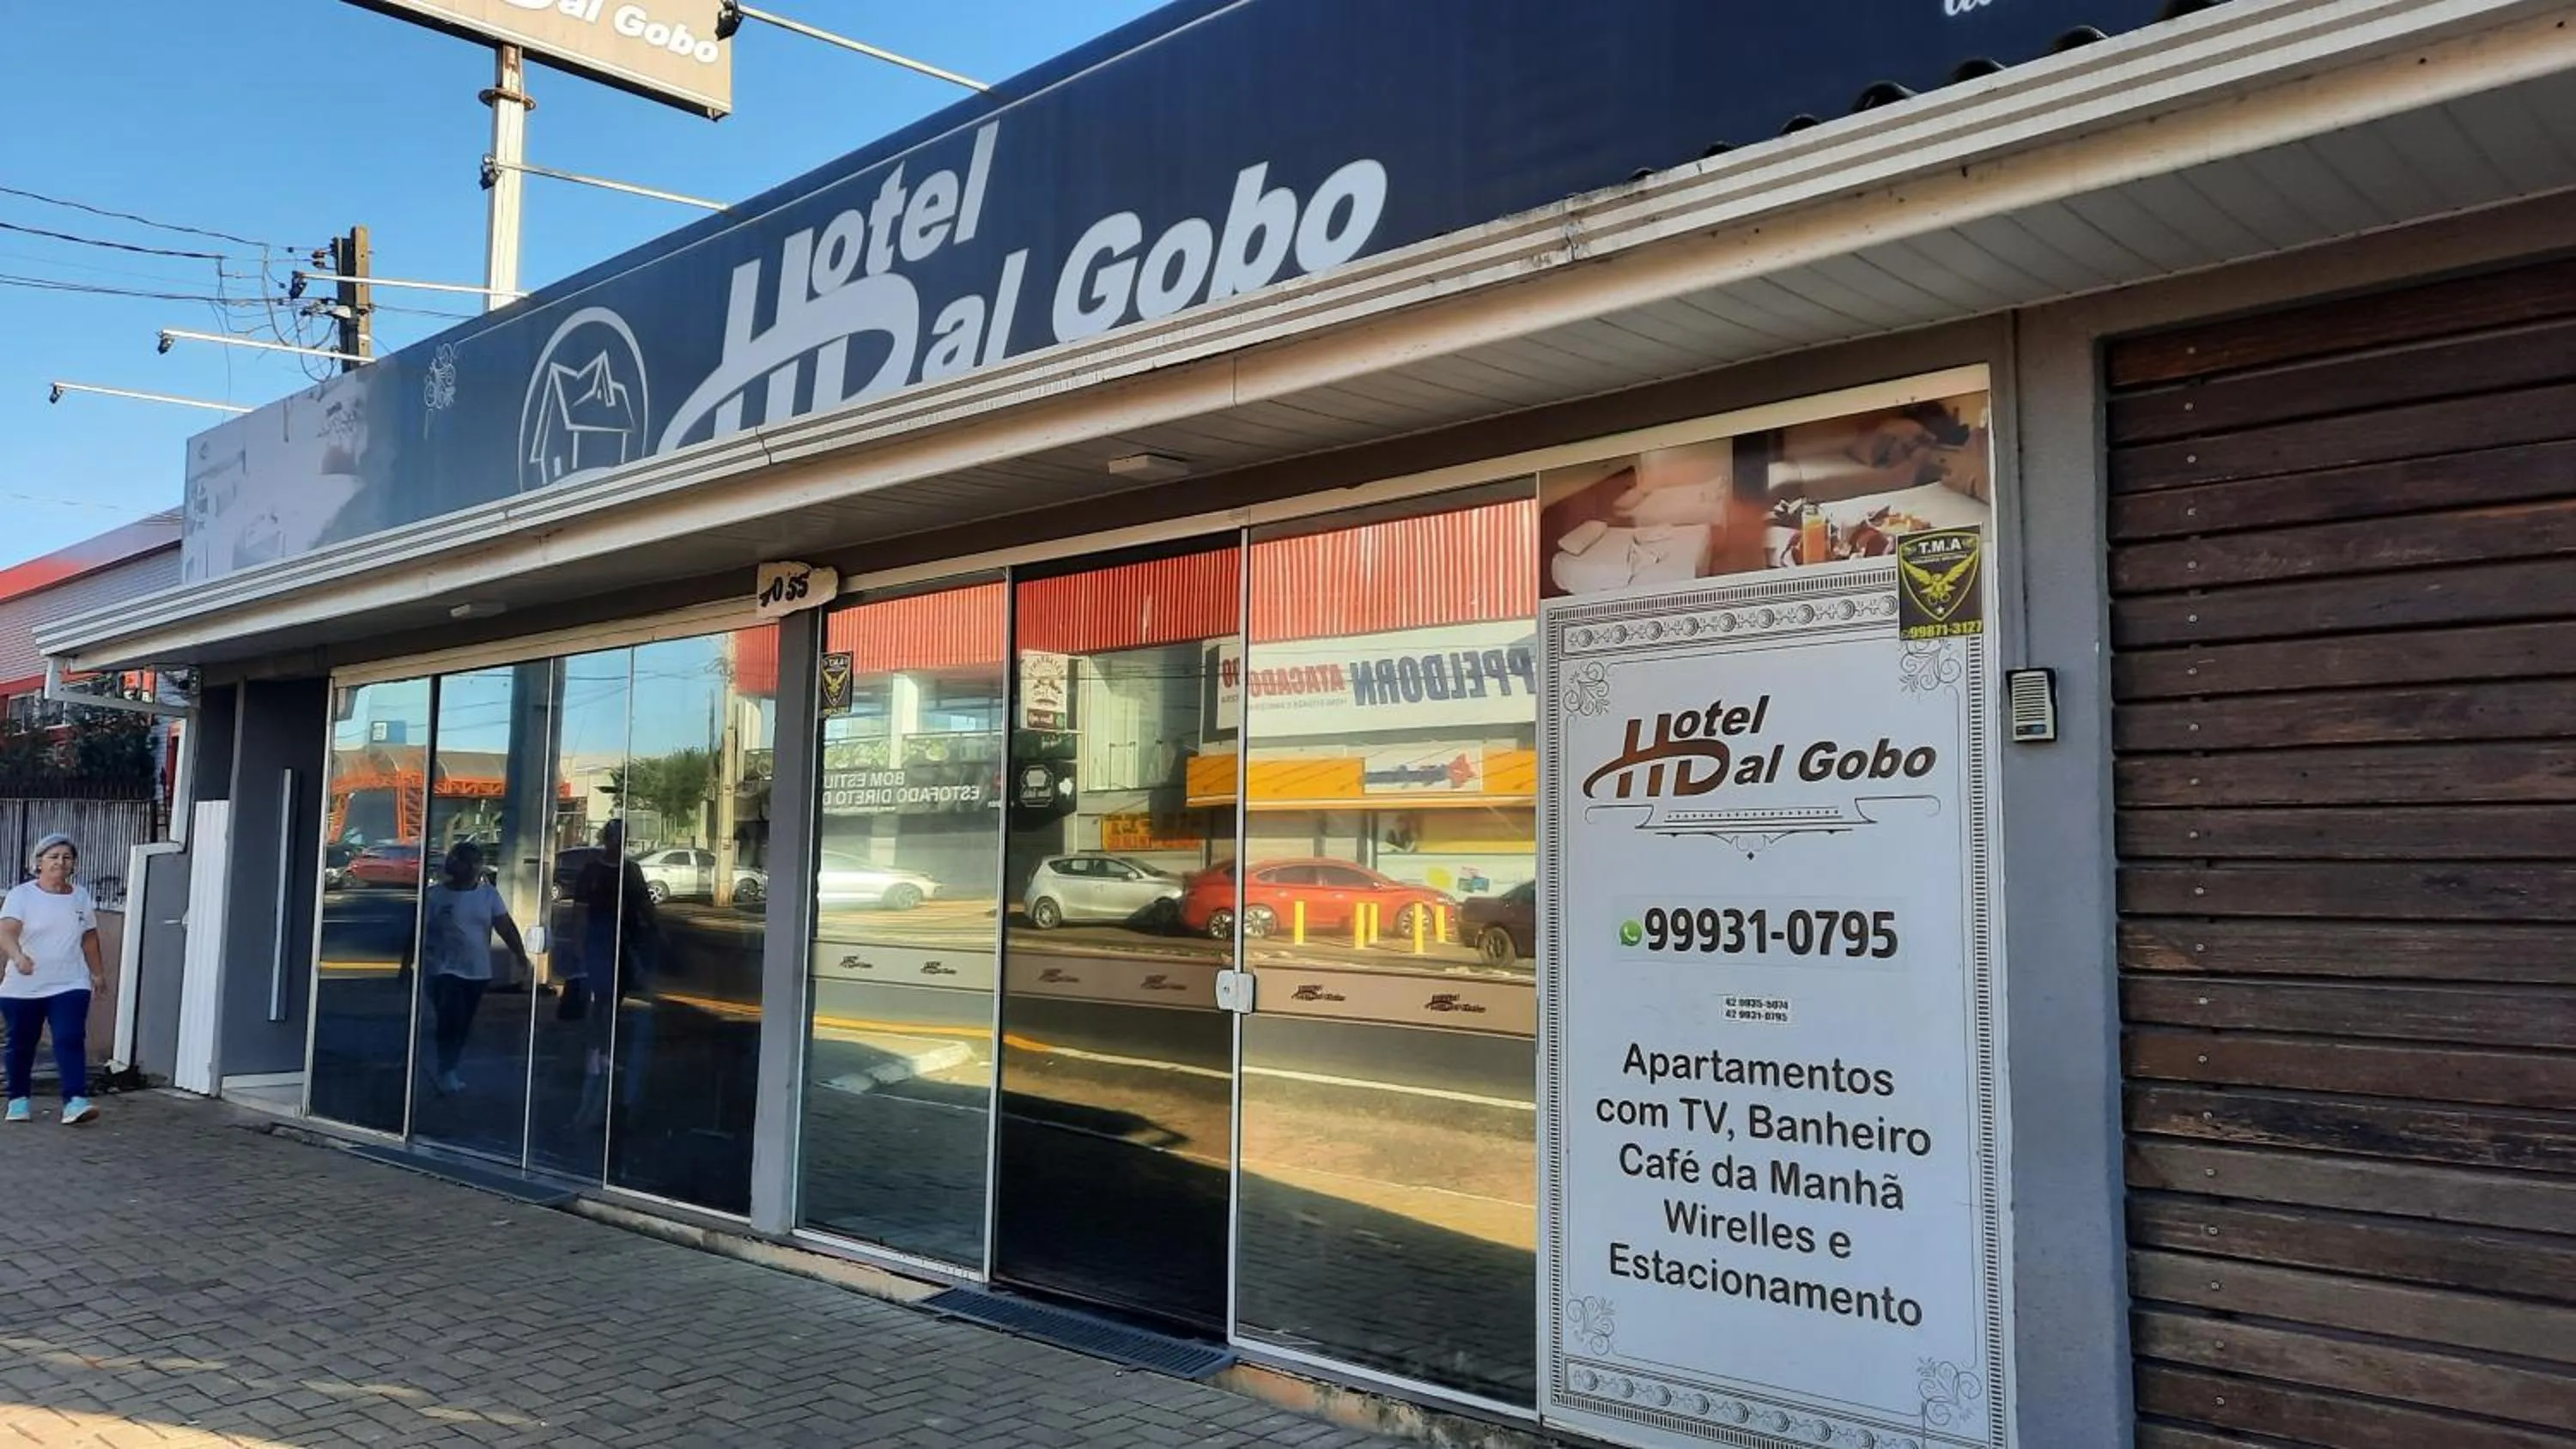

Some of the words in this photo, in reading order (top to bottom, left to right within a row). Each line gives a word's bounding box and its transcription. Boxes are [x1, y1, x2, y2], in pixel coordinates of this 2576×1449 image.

[511, 0, 601, 23] al
[614, 3, 719, 64] Gobo
[1052, 159, 1388, 343] Gobo
[658, 119, 1000, 451] Hotel
[1917, 537, 1962, 555] T.M.A
[1583, 695, 1770, 798] Hotel
[1673, 738, 1784, 797] Dal
[1798, 738, 1936, 782] Gobo
[1644, 907, 1899, 959] 99931-0795
[1623, 1042, 1895, 1096] Apartamentos
[1596, 1097, 1668, 1128] com
[1679, 1097, 1735, 1142] TV,
[1748, 1104, 1931, 1156] Banheiro
[1619, 1143, 1699, 1183] Café
[1711, 1155, 1758, 1191] da
[1771, 1160, 1905, 1210] Manhã
[1663, 1198, 1815, 1254] Wirelles
[1828, 1230, 1852, 1259] e
[1610, 1242, 1923, 1326] Estacionamento
